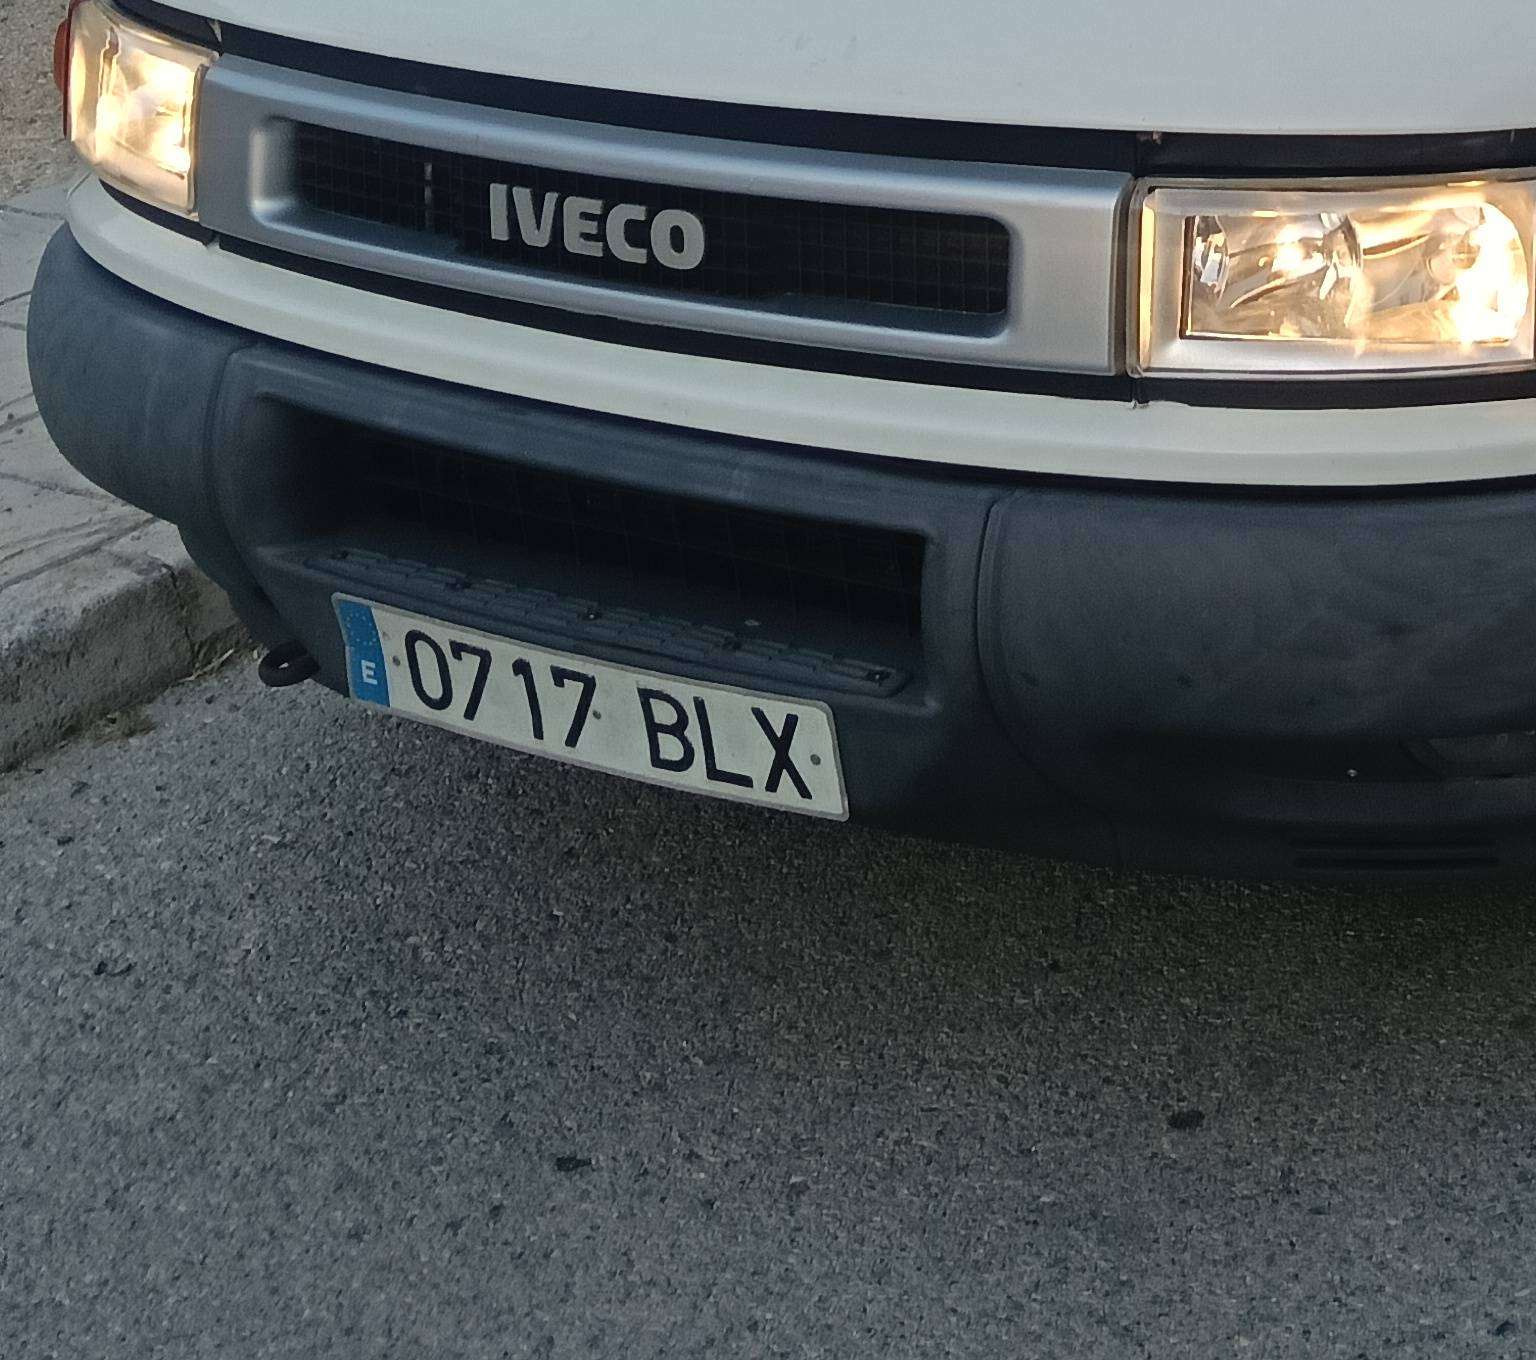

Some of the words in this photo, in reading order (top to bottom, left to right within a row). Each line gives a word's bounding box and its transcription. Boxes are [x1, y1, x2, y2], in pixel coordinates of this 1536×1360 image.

[489, 182, 706, 270] IVECO
[361, 659, 377, 685] E
[403, 628, 598, 748] 0717
[637, 686, 813, 800] BLX
